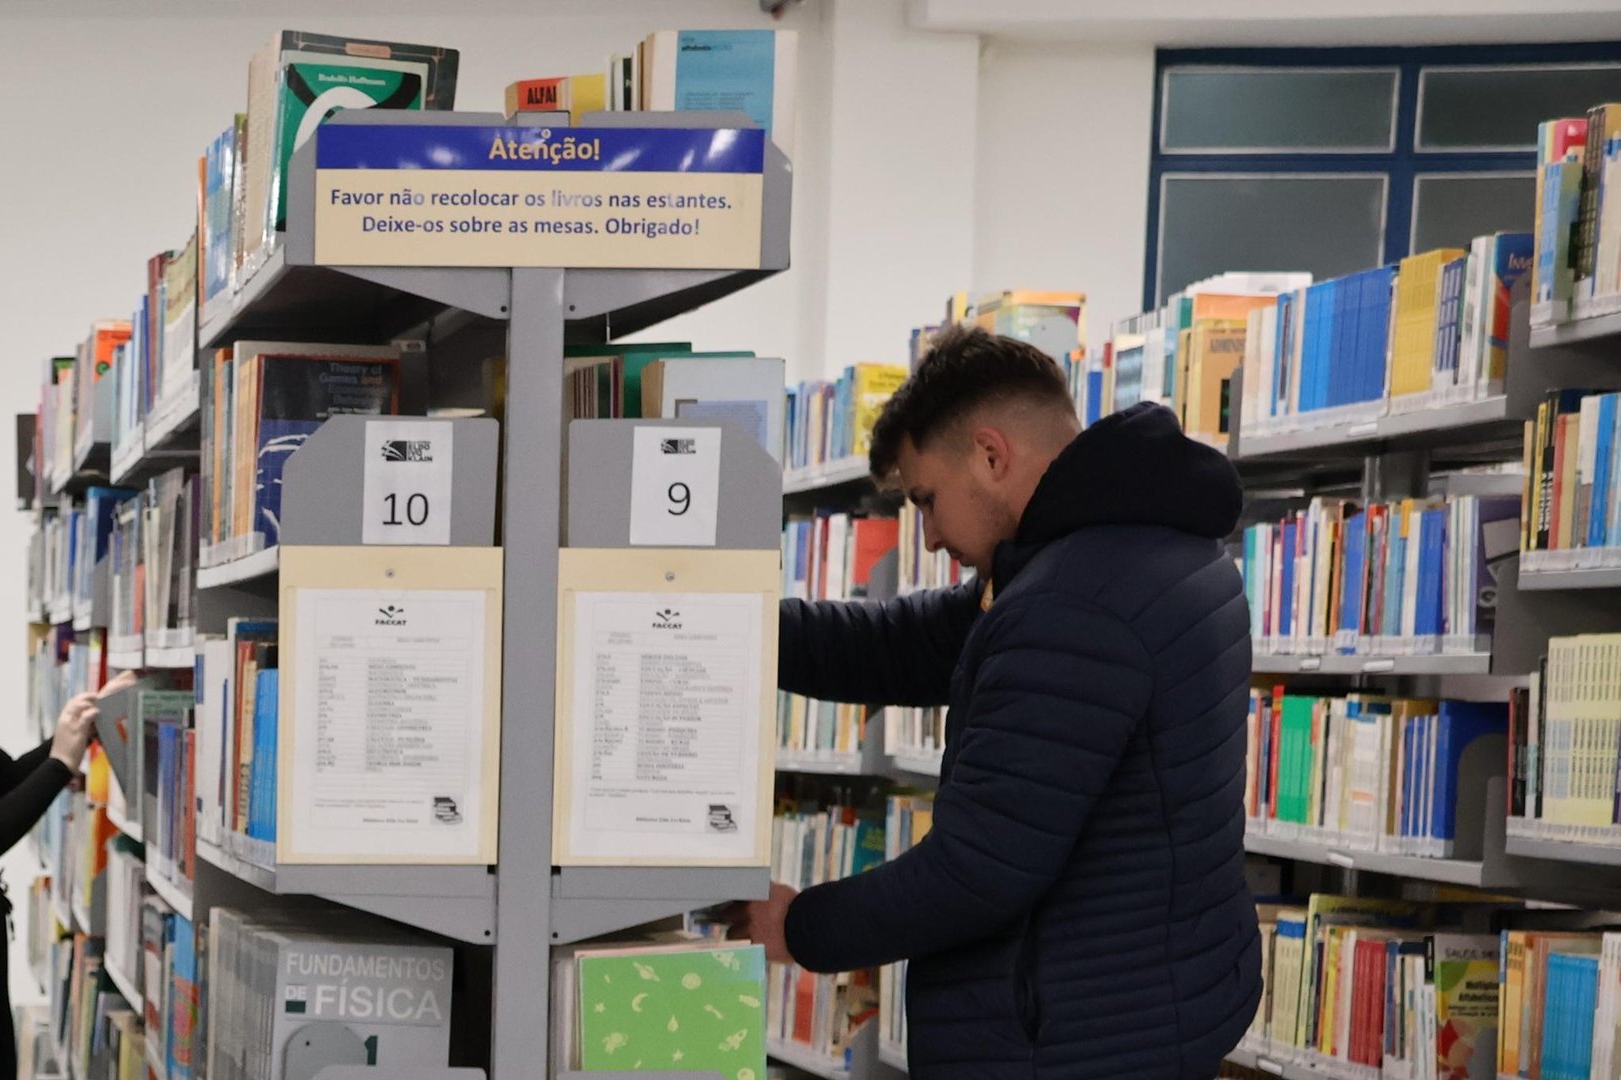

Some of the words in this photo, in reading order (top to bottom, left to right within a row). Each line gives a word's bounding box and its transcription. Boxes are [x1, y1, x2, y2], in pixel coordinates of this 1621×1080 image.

[489, 137, 600, 164] Atenção!
[331, 189, 384, 205] Favor
[390, 188, 425, 206] não
[431, 189, 519, 206] recolocar
[525, 193, 545, 207] os
[552, 190, 603, 207] livros
[609, 194, 640, 208] nas
[647, 193, 732, 209] estantes.
[363, 216, 444, 232] Deixe-os
[450, 217, 502, 233] sobre
[508, 220, 528, 233] as
[534, 220, 599, 234] mesas.
[605, 218, 700, 238] Obrigado!
[382, 492, 429, 526] 10
[668, 482, 691, 516] 9
[286, 953, 445, 981] FUNDAMENTOS
[285, 986, 308, 1000] DE
[315, 978, 442, 1020] FÍSICA
